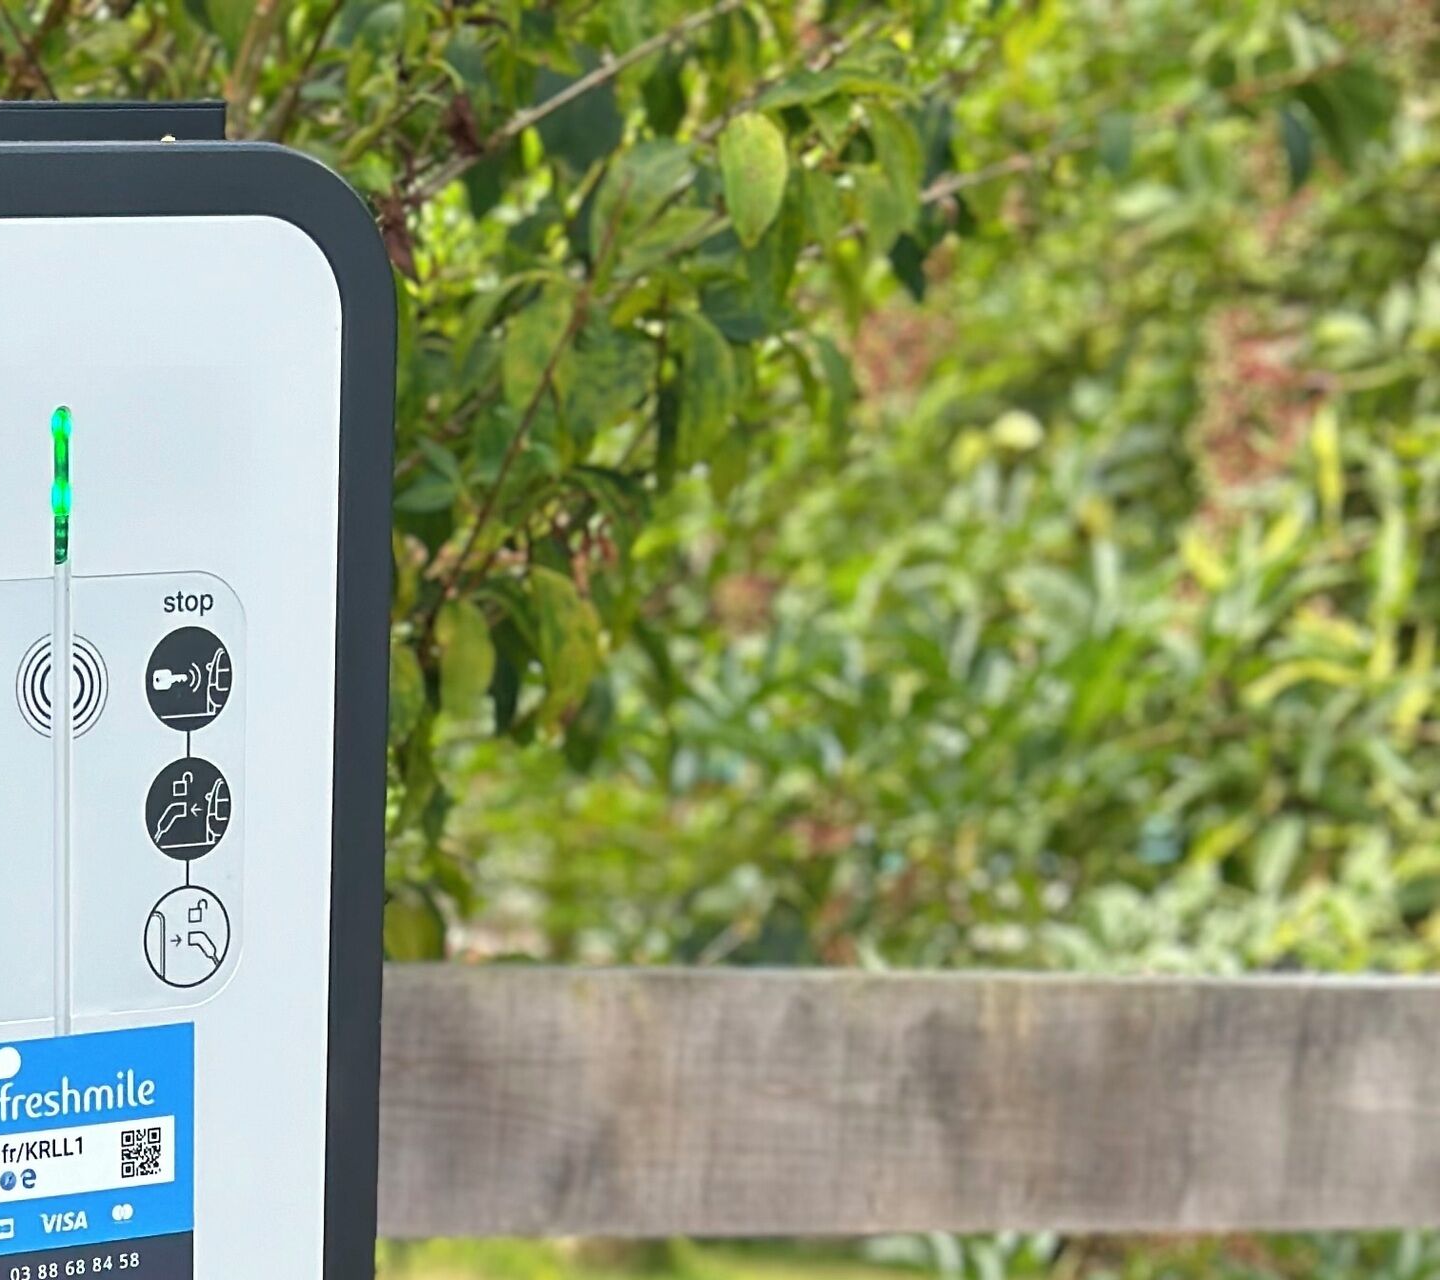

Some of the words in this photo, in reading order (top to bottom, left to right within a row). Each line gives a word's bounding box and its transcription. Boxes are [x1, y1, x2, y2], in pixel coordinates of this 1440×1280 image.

[163, 590, 214, 617] stop
[40, 1211, 88, 1233] VISA
[37, 1263, 58, 1280] 88
[65, 1260, 86, 1276] 68
[92, 1256, 113, 1273] 84
[119, 1252, 140, 1269] 58
